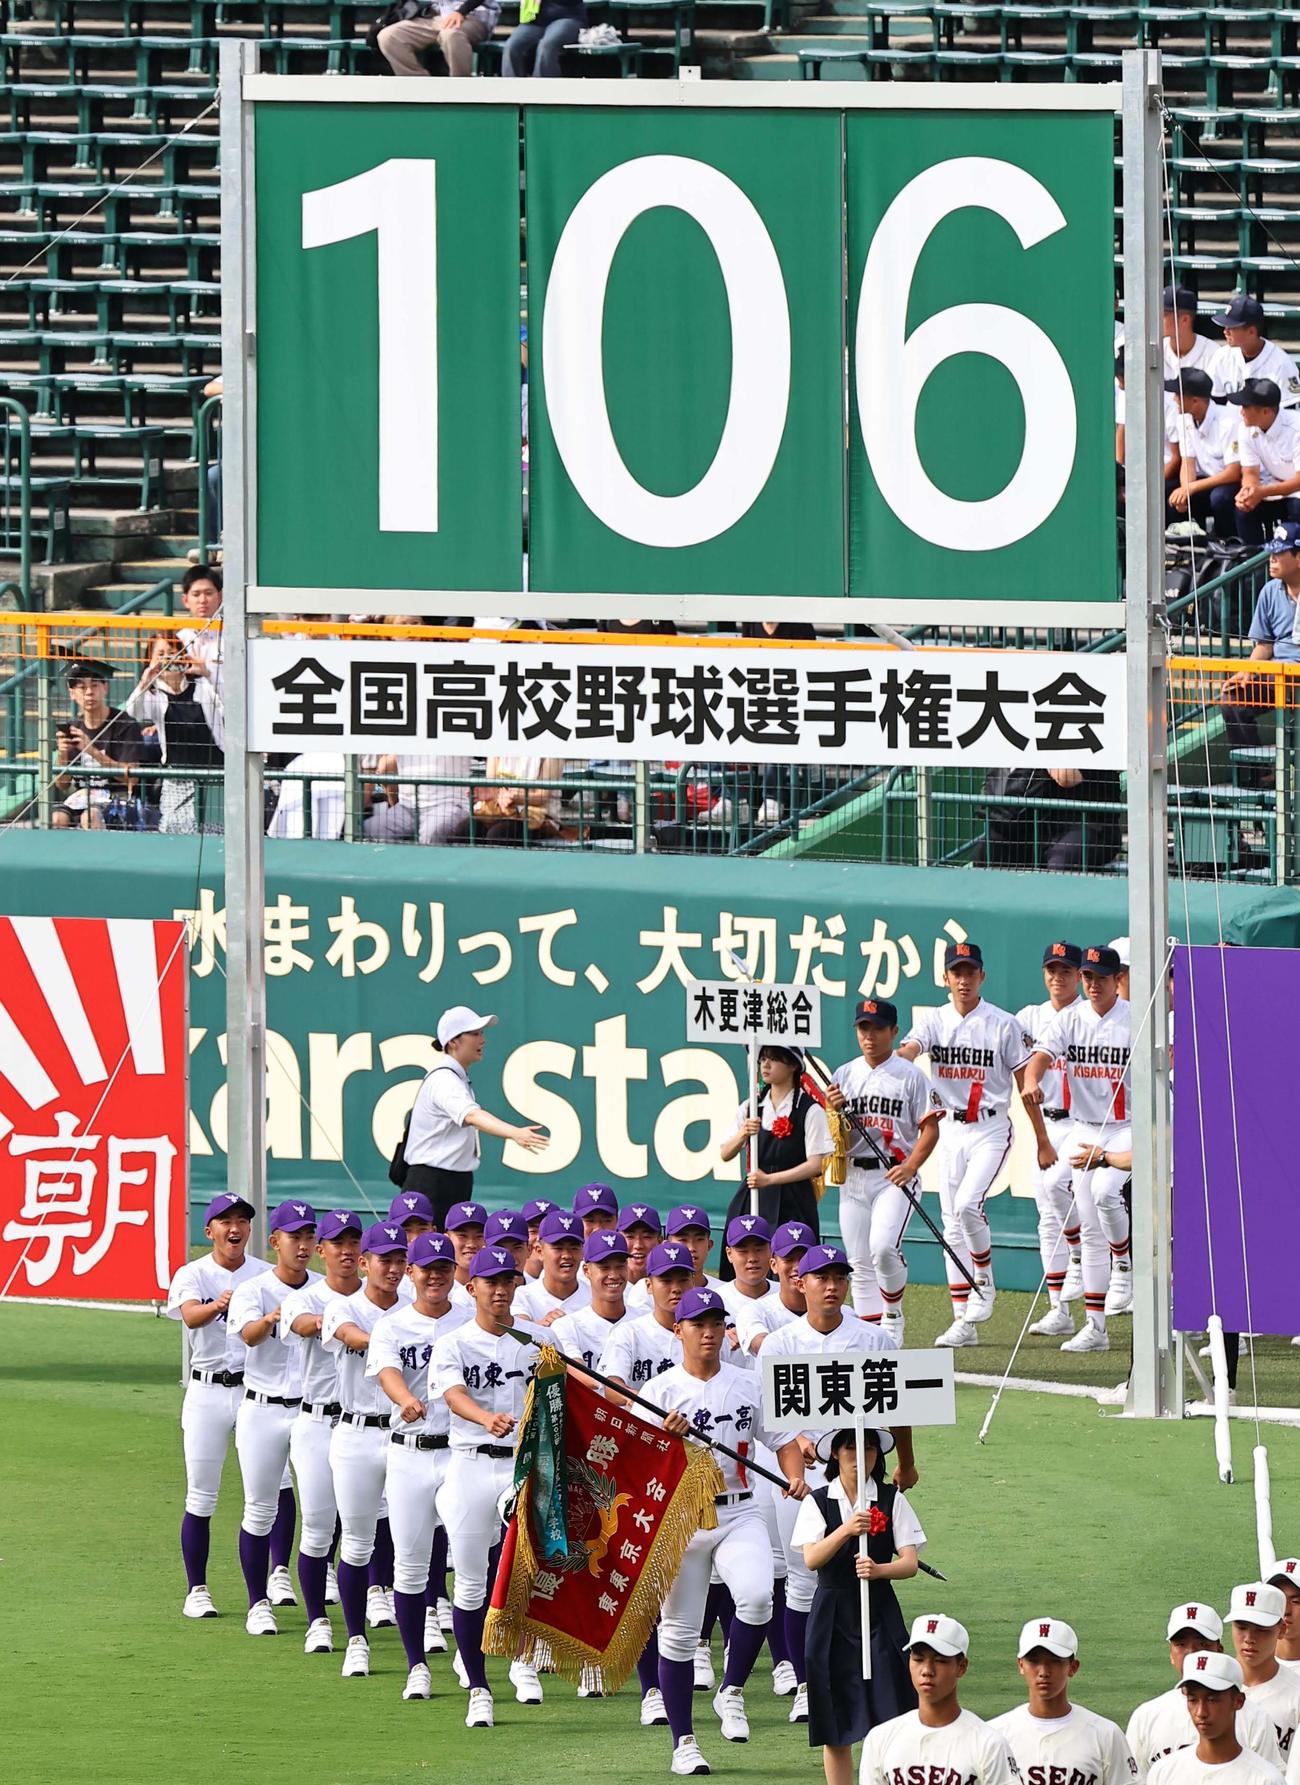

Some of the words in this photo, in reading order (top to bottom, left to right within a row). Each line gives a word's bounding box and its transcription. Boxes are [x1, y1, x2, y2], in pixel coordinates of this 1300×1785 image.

[302, 154, 1078, 552] 106
[271, 656, 1107, 755] 全国高校野球選手権大会
[693, 987, 814, 1037] 木更津総合
[938, 1065, 986, 1081] KISARAZU
[3, 1111, 178, 1290] 朝
[773, 1358, 944, 1418] 関東第一
[681, 1405, 752, 1432] 東一高
[1285, 1561, 1298, 1574] W
[1245, 1591, 1257, 1607] W
[1186, 1606, 1198, 1620] W
[926, 1619, 939, 1634] W
[1038, 1623, 1051, 1638] W
[1196, 1656, 1209, 1671] W
[884, 1765, 978, 1785] ASED
